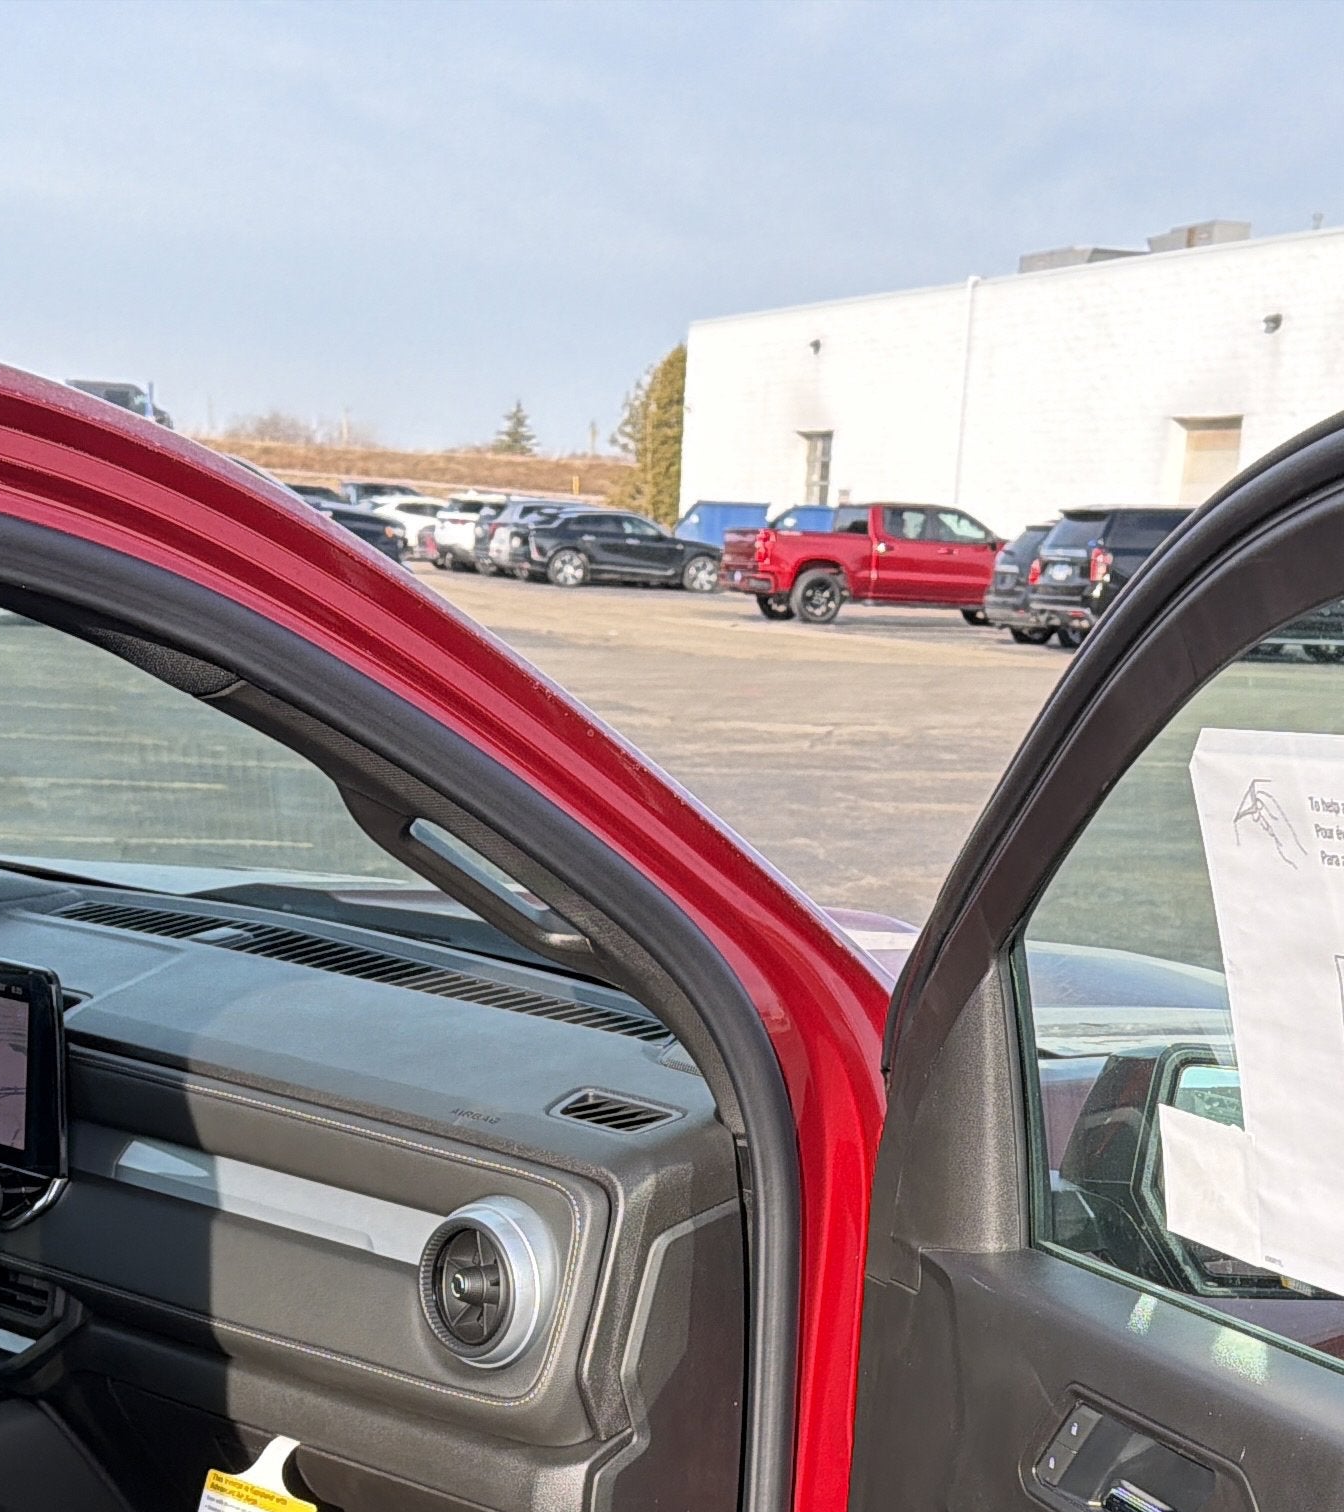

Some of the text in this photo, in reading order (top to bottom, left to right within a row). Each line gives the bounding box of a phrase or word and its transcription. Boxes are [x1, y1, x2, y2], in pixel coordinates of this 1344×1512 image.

[1308, 796, 1320, 812] To
[1320, 797, 1339, 815] help
[1314, 824, 1334, 839] Pour
[1320, 850, 1340, 866] Para
[449, 1108, 501, 1124] AIRBAG
